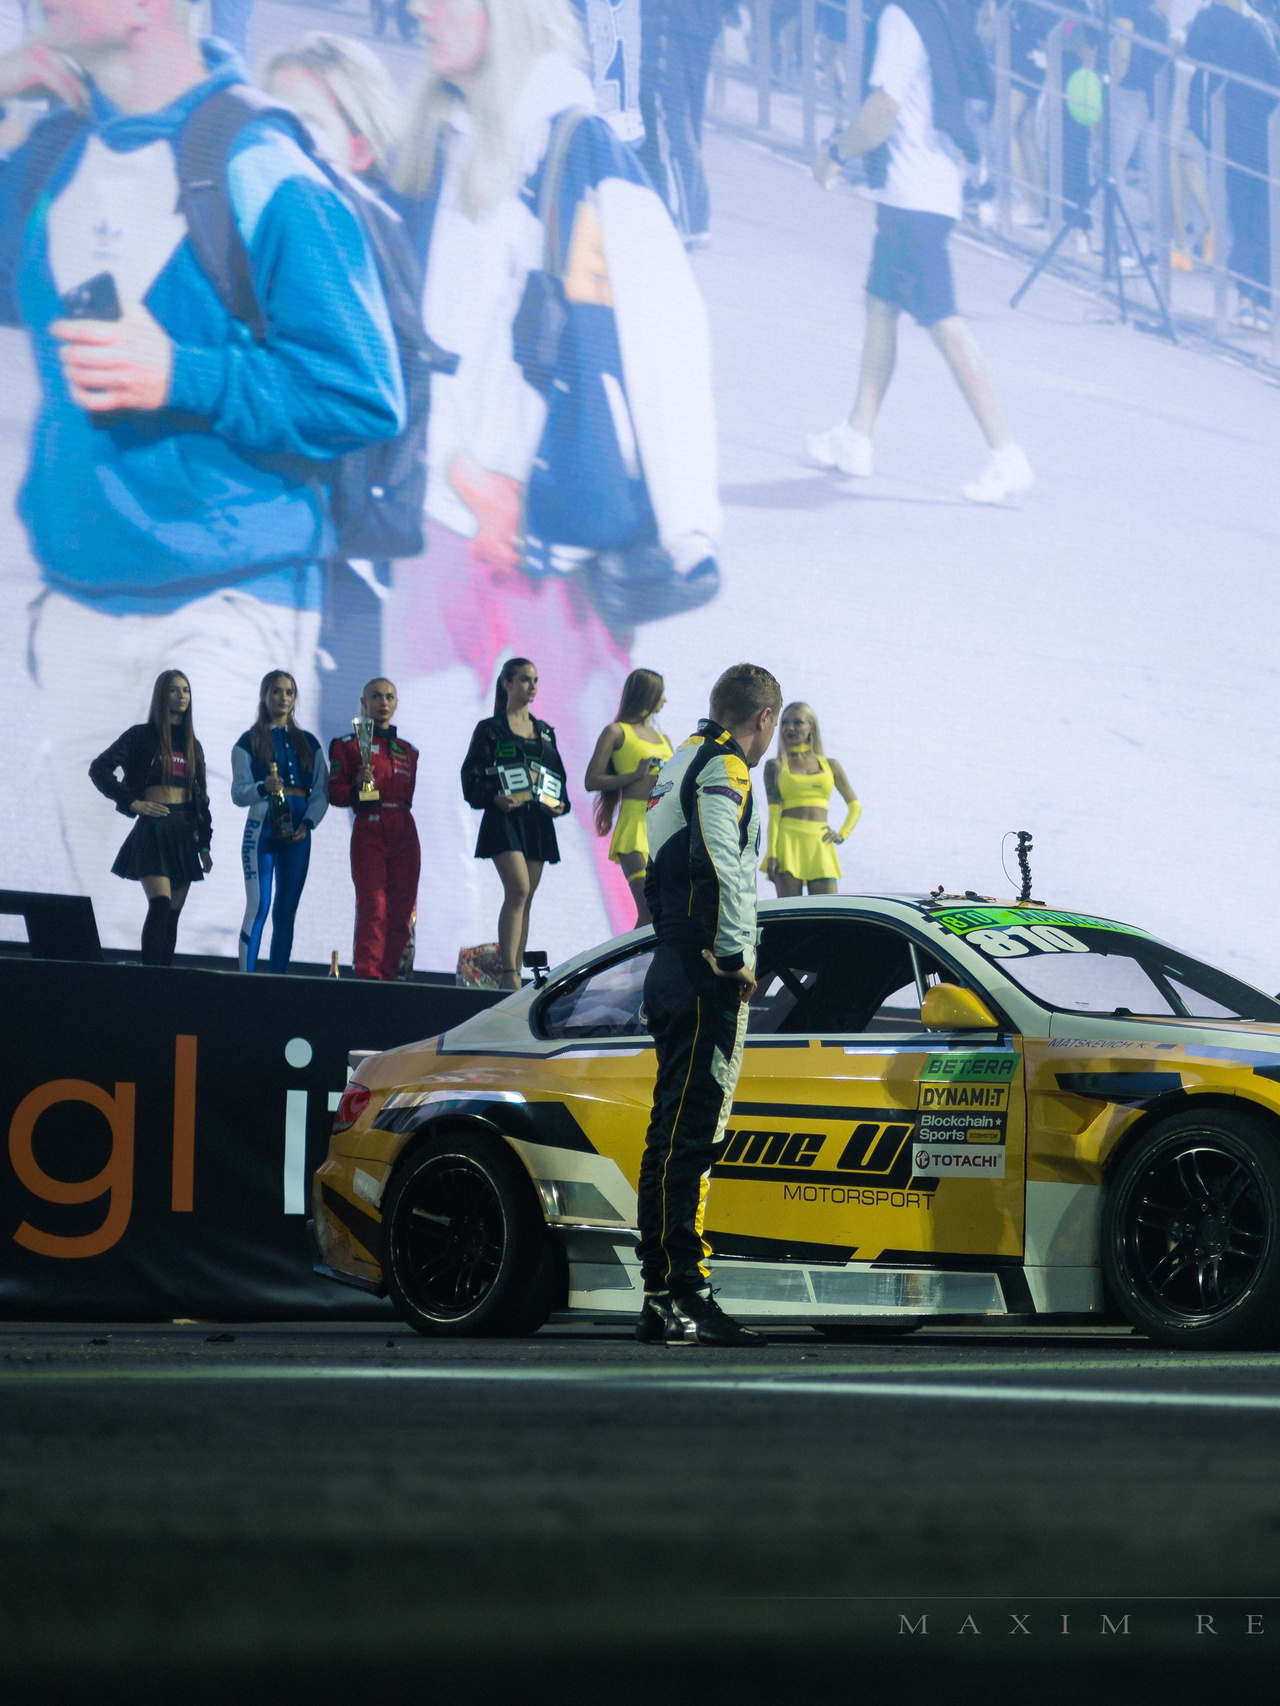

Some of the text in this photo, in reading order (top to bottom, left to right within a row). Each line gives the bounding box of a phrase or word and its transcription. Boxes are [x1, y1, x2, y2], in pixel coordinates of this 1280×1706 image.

[942, 912, 992, 928] 810
[966, 926, 1090, 957] 810
[1048, 1037, 1134, 1049] MATSKEVICH
[920, 1115, 993, 1128] Blockchain
[919, 1128, 965, 1142] Sports
[932, 1154, 998, 1167] TOTACHI
[783, 1184, 936, 1210] MOTORSPORT
